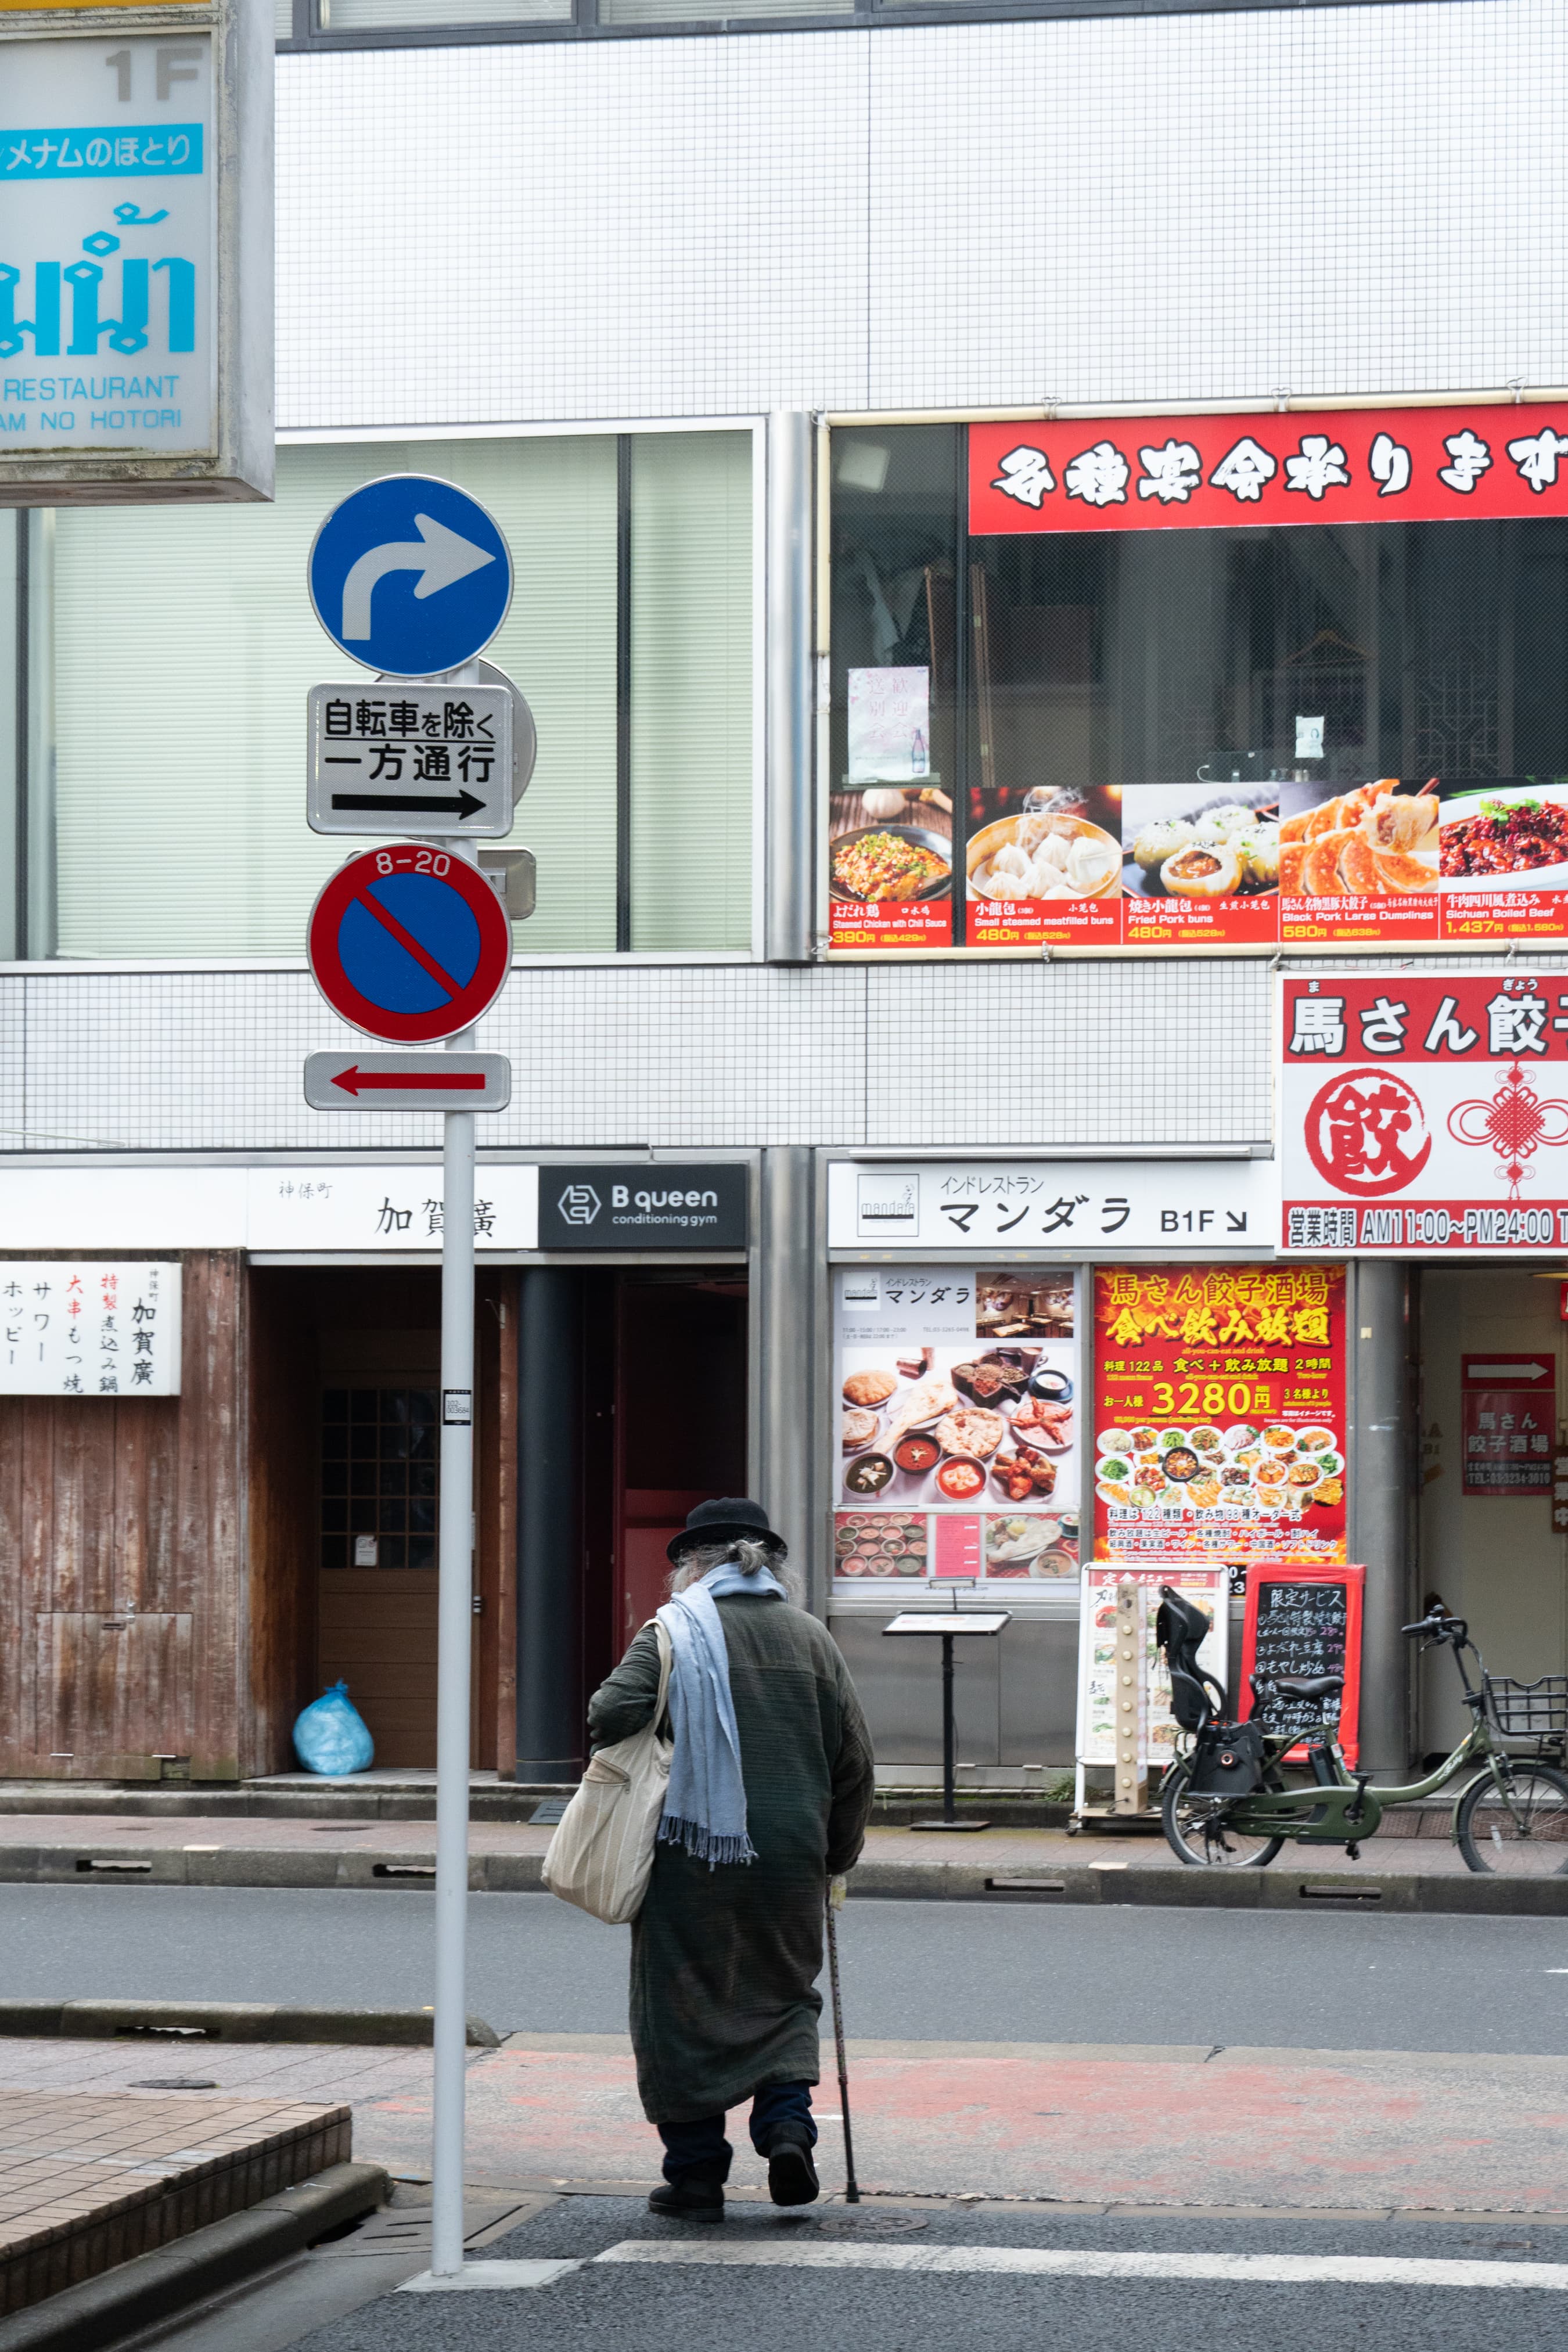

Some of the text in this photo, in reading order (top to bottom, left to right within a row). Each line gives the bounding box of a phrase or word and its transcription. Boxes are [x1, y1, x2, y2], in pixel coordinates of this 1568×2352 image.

[106, 48, 203, 102] 1F
[3, 375, 179, 401] RESTAURANT
[41, 411, 75, 430] NO
[91, 409, 181, 430] HOTORI
[324, 702, 494, 739] 自転車を除く
[324, 743, 495, 784] 一方通行
[376, 850, 451, 877] 8-20
[975, 901, 1016, 916] 小龍包
[1128, 898, 1193, 914] 焼き小龍包
[1446, 893, 1541, 908] 牛肉四川風煮込み
[925, 919, 947, 927] Sauce
[974, 917, 999, 927] Small
[1002, 917, 1041, 926] steamed
[1091, 916, 1114, 925] buns
[1128, 914, 1214, 925] Fried Pork buns
[1282, 911, 1434, 922] Black Pork Large Dumplings
[1445, 907, 1555, 919] Sichuan Boiled Beef
[833, 931, 876, 943] 390円
[976, 928, 1019, 941] 480円
[1128, 926, 1172, 938] 480円
[1283, 925, 1327, 938] 580円
[1308, 981, 1320, 993] ま
[1290, 995, 1568, 1055] 馬さん餃
[279, 1181, 333, 1199] 神保町
[940, 1175, 1044, 1195] インドレストラン
[634, 1191, 718, 1213] queen
[612, 1213, 718, 1227] conditioning gym
[940, 1194, 1214, 1234] マンダラ B1F
[1289, 1207, 1357, 1247] 営業時間
[886, 1286, 970, 1304] マンダラ
[1110, 1273, 1330, 1306] 馬さん餃子酒場
[2, 1281, 23, 1365] ホッピー
[33, 1281, 52, 1362] サワー
[1106, 1307, 1332, 1347] 食べ飲み放題
[63, 1274, 84, 1394] 大串もつ焼
[99, 1273, 120, 1393] 特製煮込み鍋
[1152, 1382, 1251, 1416] 3280
[1479, 1412, 1538, 1430] 馬さん
[1468, 1434, 1549, 1453] 餃子酒場
[1271, 1588, 1346, 1608] 限定サービス
